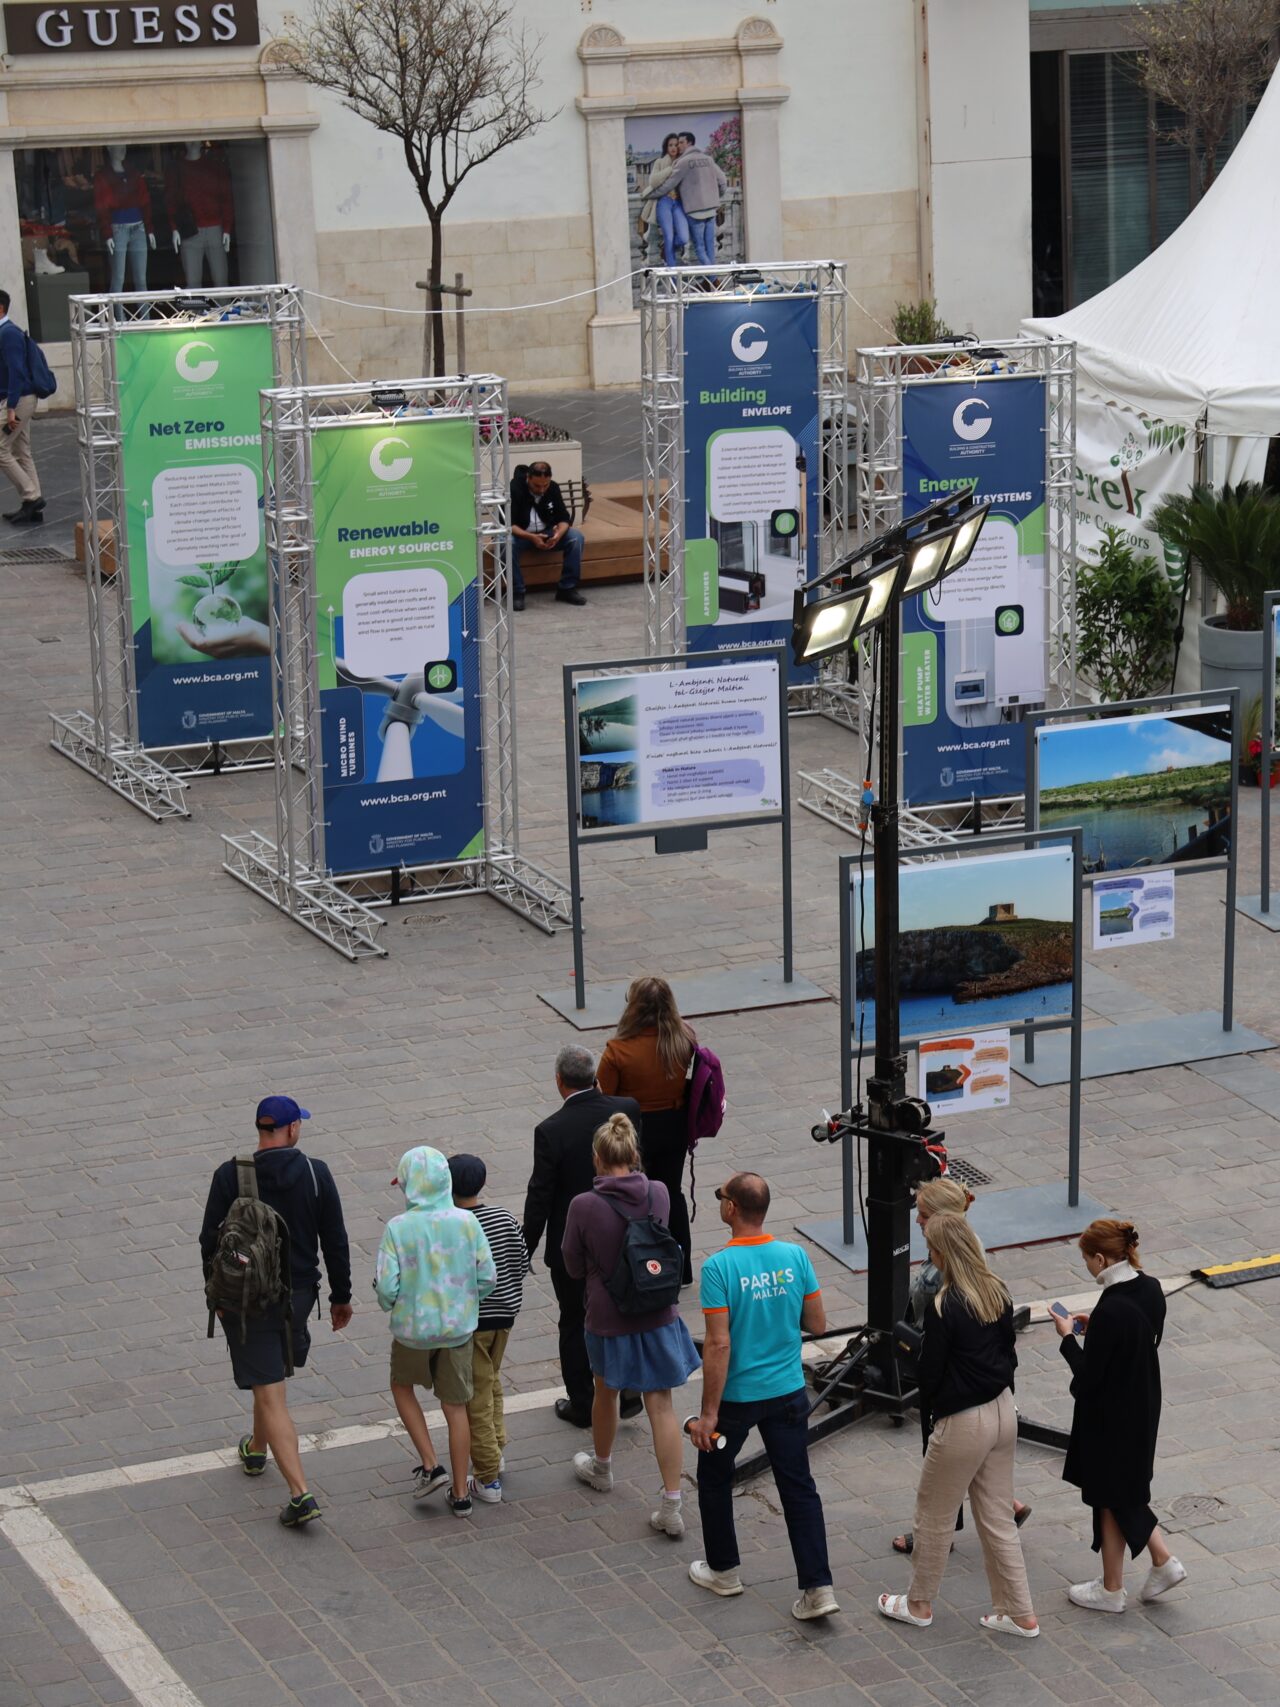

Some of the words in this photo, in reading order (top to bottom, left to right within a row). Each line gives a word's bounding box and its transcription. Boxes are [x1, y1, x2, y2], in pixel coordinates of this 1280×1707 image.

[36, 4, 237, 47] GUESS
[700, 388, 766, 404] Building
[742, 406, 792, 416] ENVELOPE
[149, 422, 181, 436] Net
[184, 420, 224, 434] Zero
[185, 434, 262, 450] EMISSIONS
[920, 477, 978, 494] Energy
[984, 492, 1032, 504] SYSTEMS
[338, 520, 439, 542] Renewable
[350, 545, 396, 558] ENERGY
[399, 541, 454, 554] SOURCES
[718, 638, 786, 650] www.bca.org.mt
[173, 670, 259, 685] www.bca.org.mt
[670, 678, 715, 688] L-Ambjenti
[938, 738, 1010, 752] www.bca.org.mt
[360, 790, 447, 807] www.bca.org.mt
[740, 1268, 794, 1292] PARKS
[753, 1286, 787, 1301] MALTA
